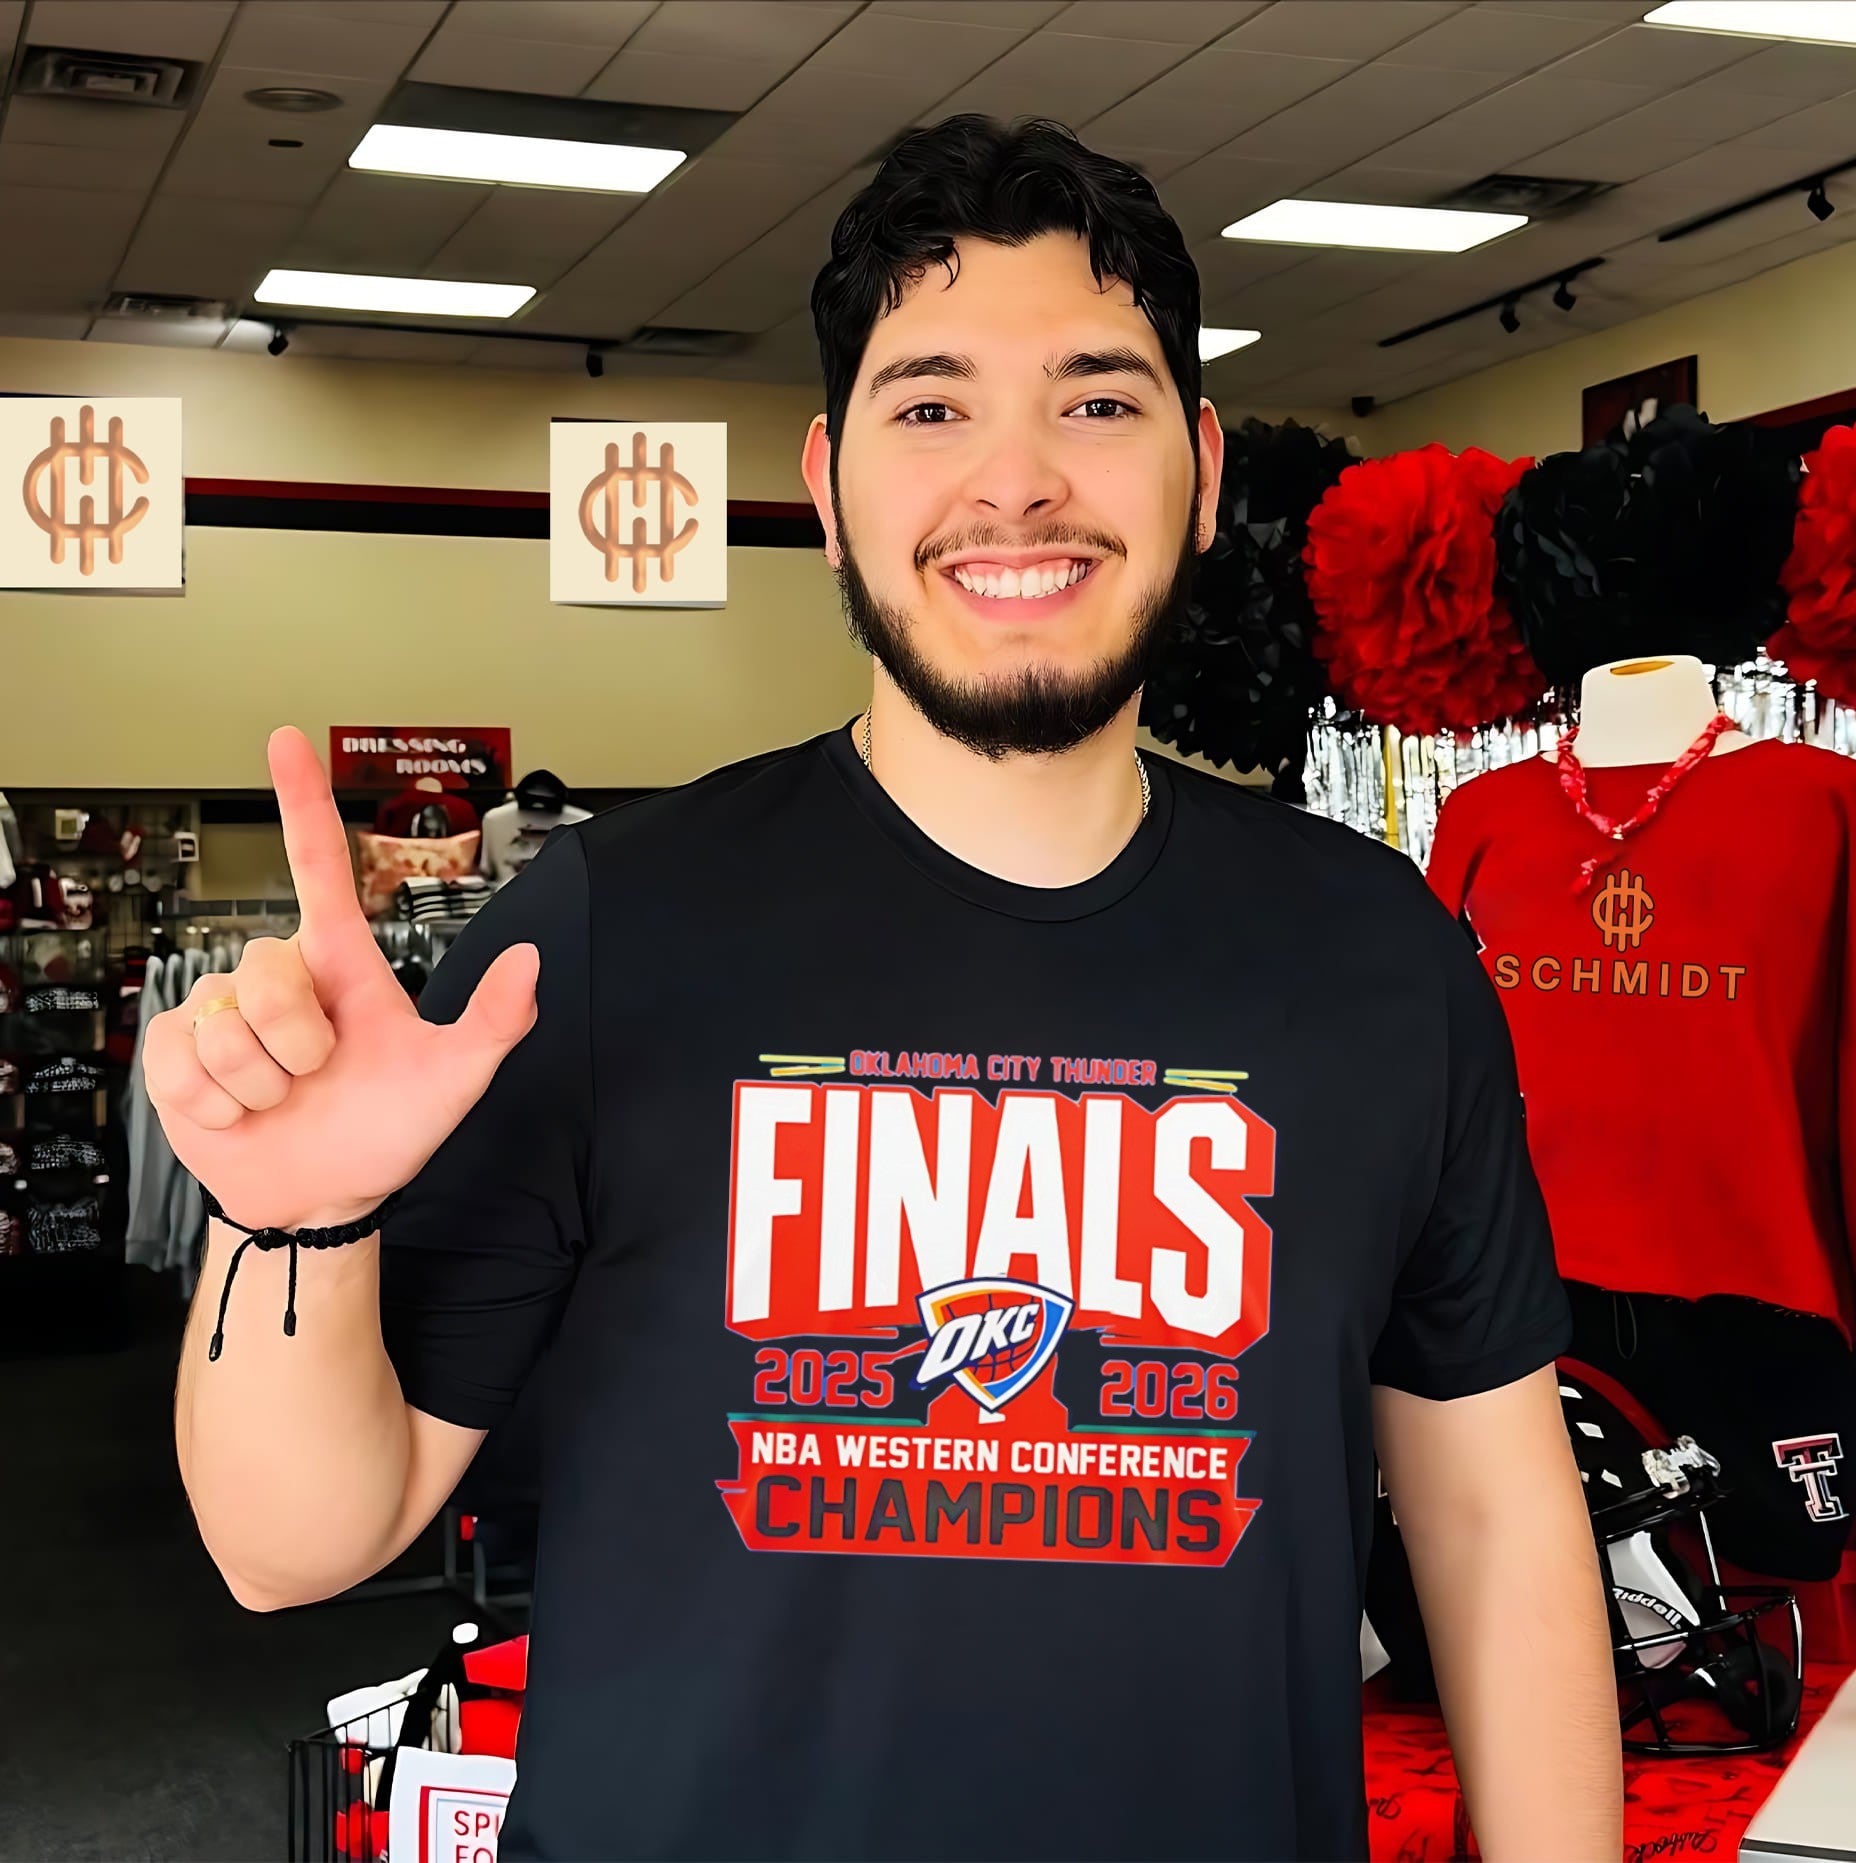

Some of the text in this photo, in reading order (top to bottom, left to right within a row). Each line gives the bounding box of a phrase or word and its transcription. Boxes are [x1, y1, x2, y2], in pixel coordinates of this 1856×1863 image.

[342, 737, 467, 754] DRESSING
[396, 759, 487, 775] ROOMS
[1494, 953, 1746, 1000] SCHMIDT
[849, 1049, 1157, 1086] OKLAHOMA CITY THUNDER
[732, 1086, 1248, 1339] FINALS
[916, 1303, 1040, 1384] OKC
[754, 1348, 894, 1408] 2025
[1101, 1360, 1239, 1420] 2026
[751, 1431, 1228, 1480] NBA WESTERN CONFERENCE
[755, 1475, 1222, 1553] CHAMPIONS
